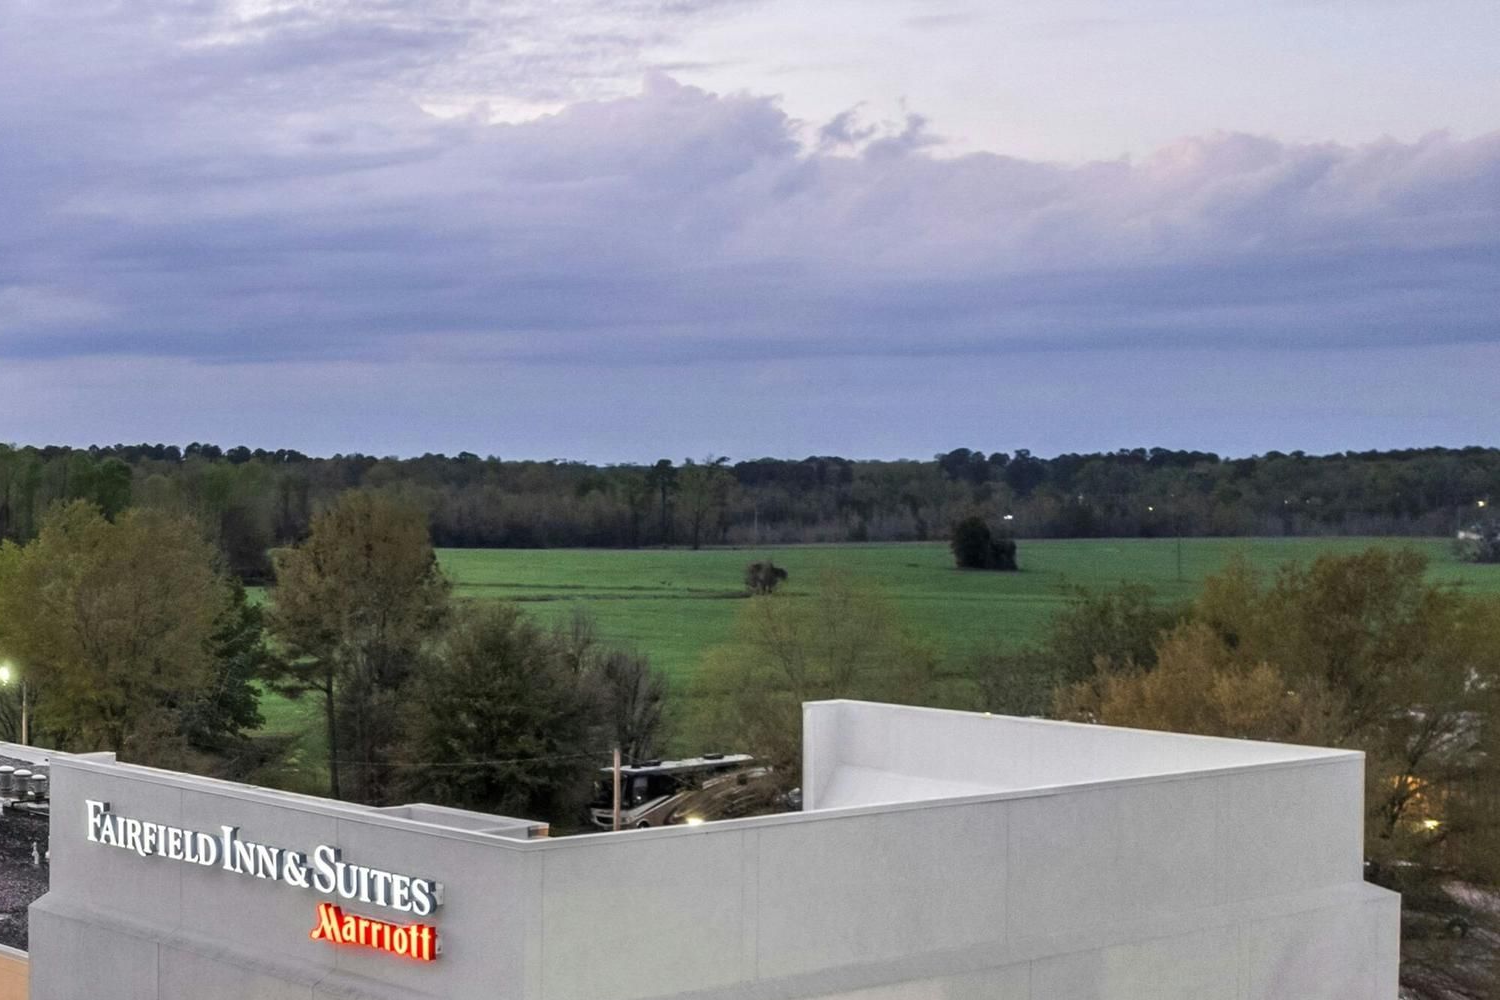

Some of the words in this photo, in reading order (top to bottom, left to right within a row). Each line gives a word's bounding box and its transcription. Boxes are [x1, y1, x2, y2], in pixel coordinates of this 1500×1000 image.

[85, 799, 217, 866] FAIRFIELD
[221, 825, 279, 880] INN
[283, 851, 310, 888] &
[314, 844, 432, 915] SUITES
[311, 903, 432, 961] Marriott
